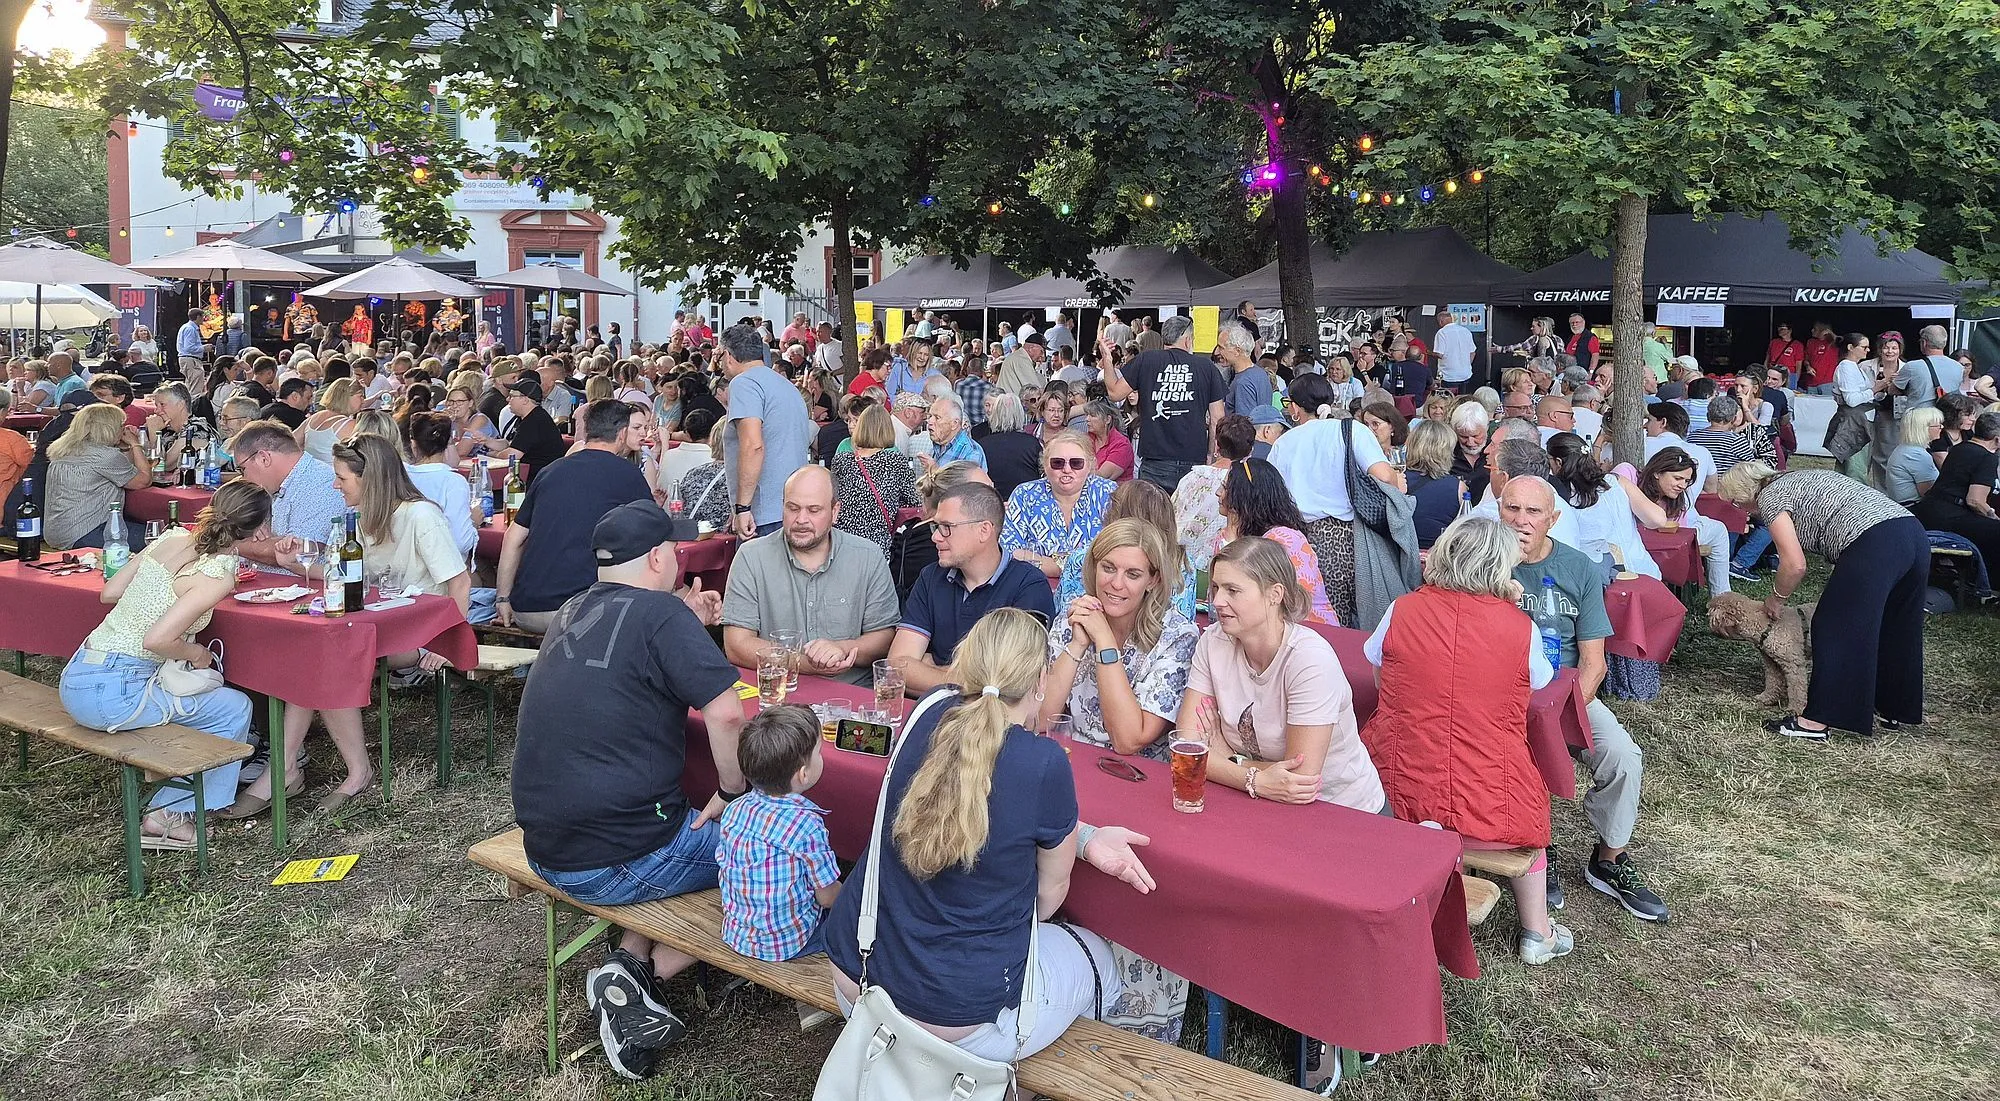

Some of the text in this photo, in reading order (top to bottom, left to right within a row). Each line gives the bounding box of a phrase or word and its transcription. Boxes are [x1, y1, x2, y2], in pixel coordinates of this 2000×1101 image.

[1533, 289, 1611, 302] GETRÄNKE
[1658, 286, 1730, 301] KAFFEE
[1795, 287, 1879, 302] KUCHEN
[121, 291, 145, 308] EDU
[919, 298, 967, 309] FLAMMKUCHEN
[1065, 297, 1099, 308] CRÊPES
[1318, 322, 1354, 342] CK
[1164, 364, 1190, 374] AUS
[1156, 372, 1194, 383] LIEBE
[1160, 382, 1188, 392] ZUR
[1151, 391, 1195, 402] MUSIK
